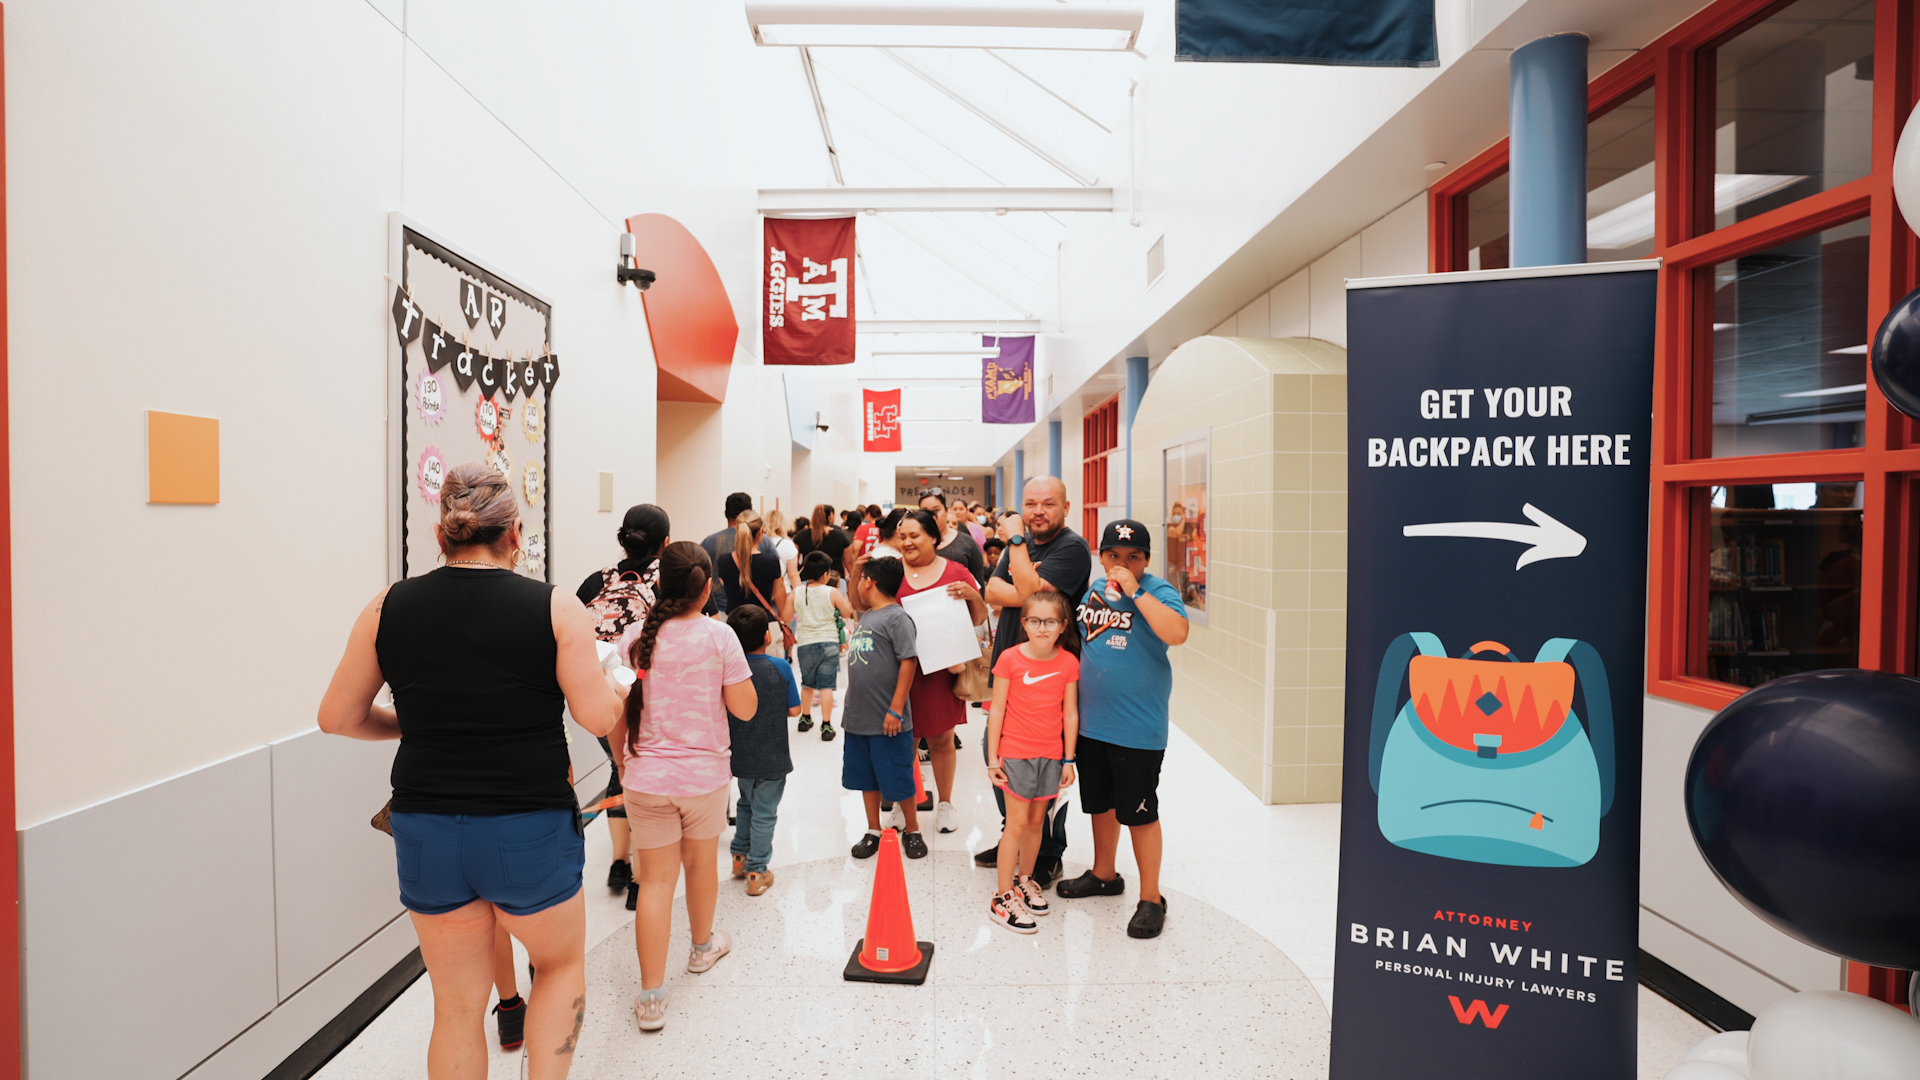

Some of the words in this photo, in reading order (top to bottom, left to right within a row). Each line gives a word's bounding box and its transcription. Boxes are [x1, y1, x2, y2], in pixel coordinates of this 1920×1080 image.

[769, 247, 786, 328] AGGIES
[464, 284, 503, 329] AR
[401, 297, 554, 395] Tracker
[423, 380, 438, 393] 130
[1420, 389, 1474, 419] GET
[1484, 386, 1573, 418] YOUR
[482, 403, 493, 415] 170
[428, 460, 440, 474] 140
[1368, 436, 1535, 467] BACKPACK
[1547, 434, 1631, 466] HERE
[1076, 604, 1133, 629] Doritos
[1434, 910, 1532, 932] ATTORNEY
[1351, 923, 1467, 958] BRIAN
[1490, 942, 1624, 981] WHITE
[1375, 960, 1453, 980] PERSONAL
[1459, 971, 1515, 989] INJURY
[1521, 981, 1596, 1003] LAWYERS
